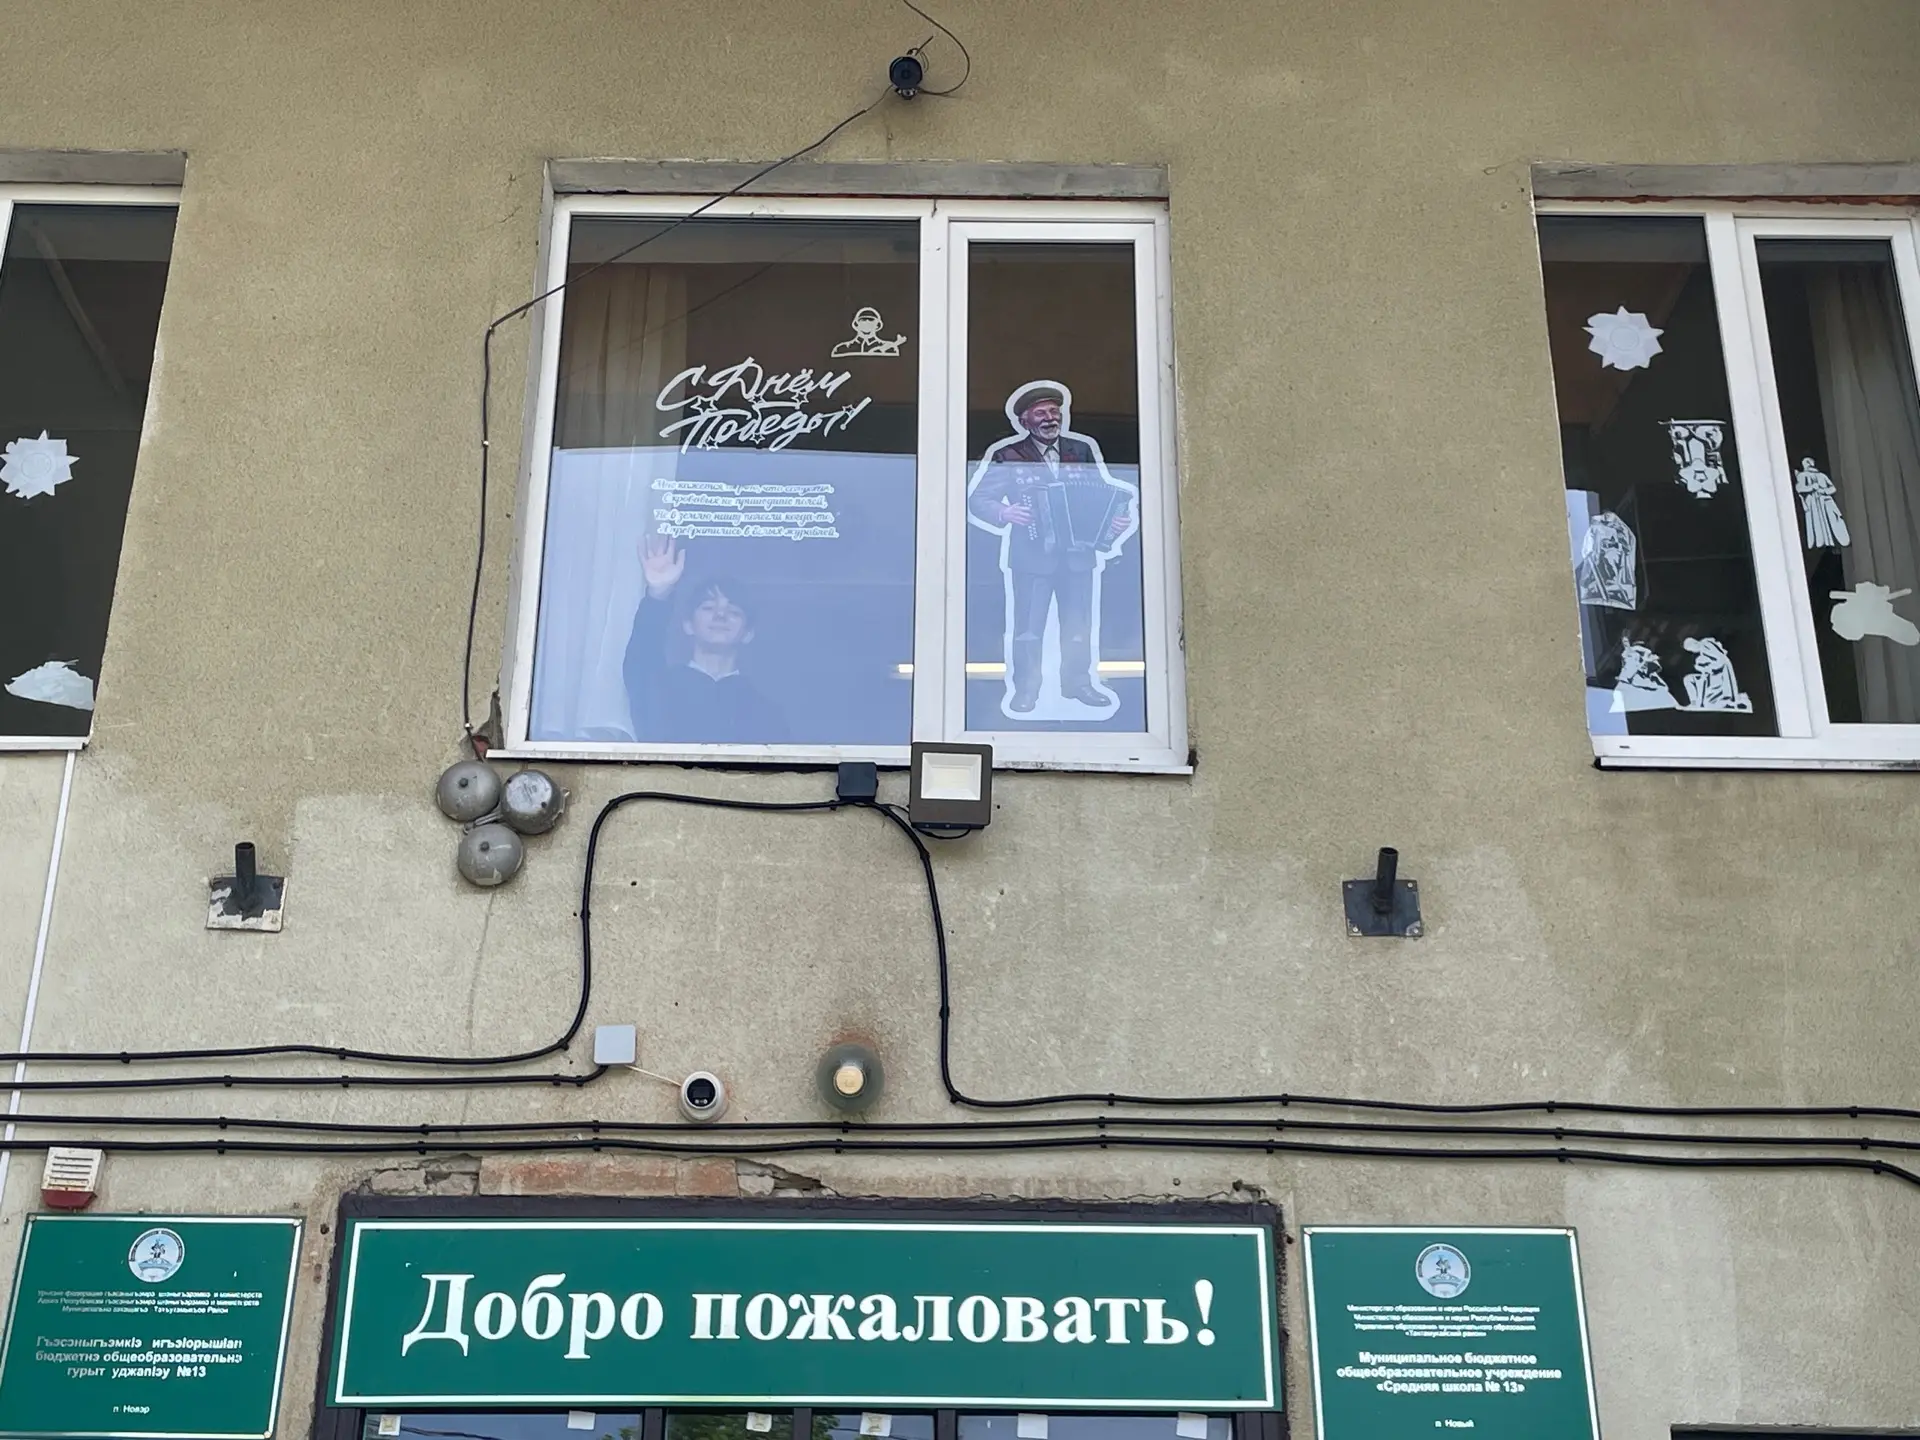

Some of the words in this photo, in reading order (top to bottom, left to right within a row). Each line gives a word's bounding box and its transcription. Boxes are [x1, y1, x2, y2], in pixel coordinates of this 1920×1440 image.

[656, 365, 706, 411] С
[708, 357, 851, 400] Днём
[659, 397, 872, 455] Победы!
[402, 1273, 663, 1359] Добро
[690, 1278, 1217, 1346] пожаловать!
[1359, 1351, 1462, 1365] Муниципальное
[1464, 1352, 1537, 1365] бюджетное
[176, 1366, 207, 1378] №13
[1336, 1366, 1482, 1379] общеобразовательное
[1485, 1367, 1562, 1380] учреждение
[1377, 1380, 1439, 1393] «Средняя
[1442, 1381, 1482, 1393] школа
[1486, 1381, 1500, 1392] №
[1503, 1381, 1525, 1393] 13»
